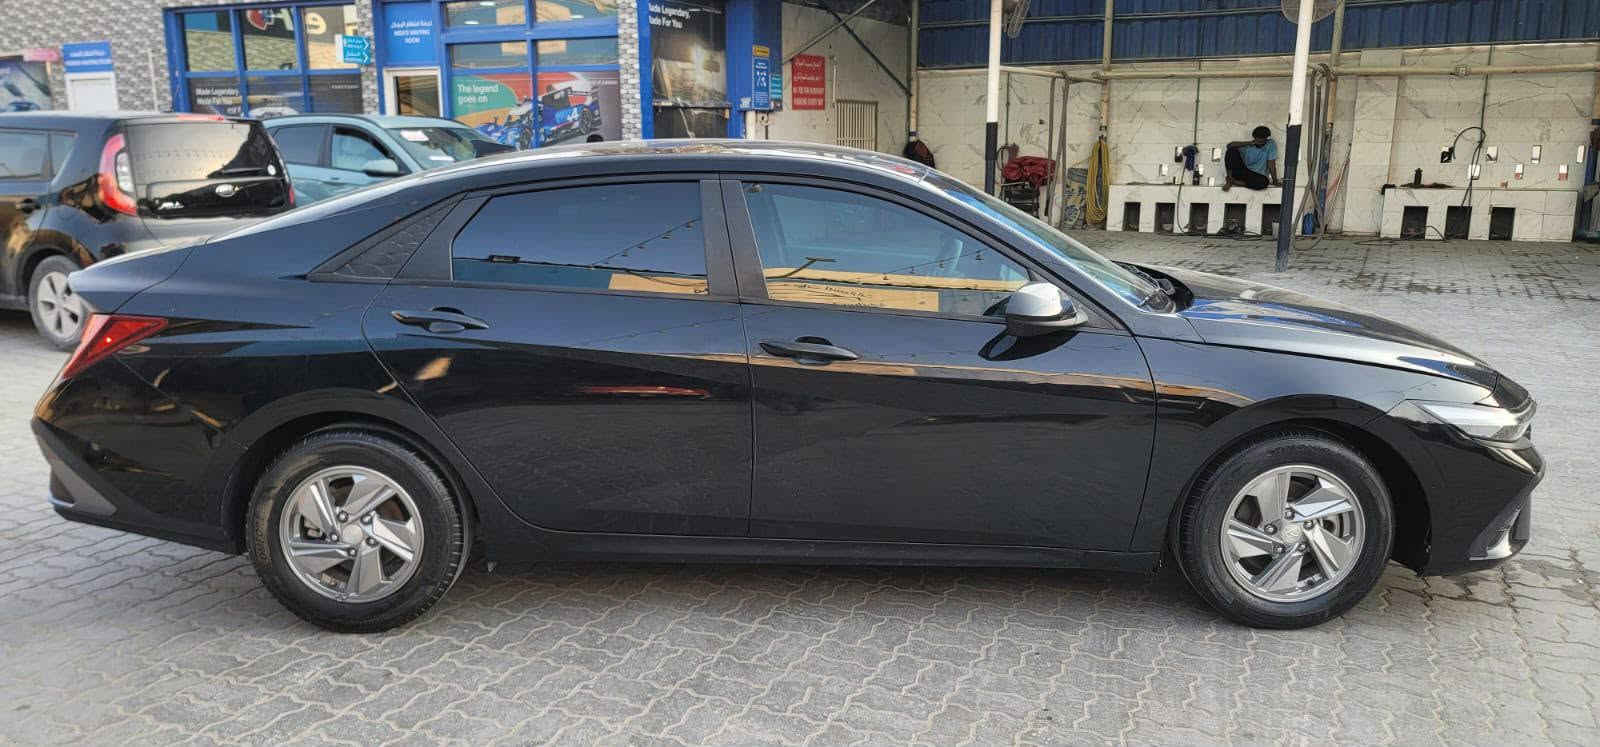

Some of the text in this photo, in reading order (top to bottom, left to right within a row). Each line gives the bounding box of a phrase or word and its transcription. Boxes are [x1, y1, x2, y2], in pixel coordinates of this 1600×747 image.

[457, 84, 499, 95] The legend
[458, 95, 476, 105] goes
